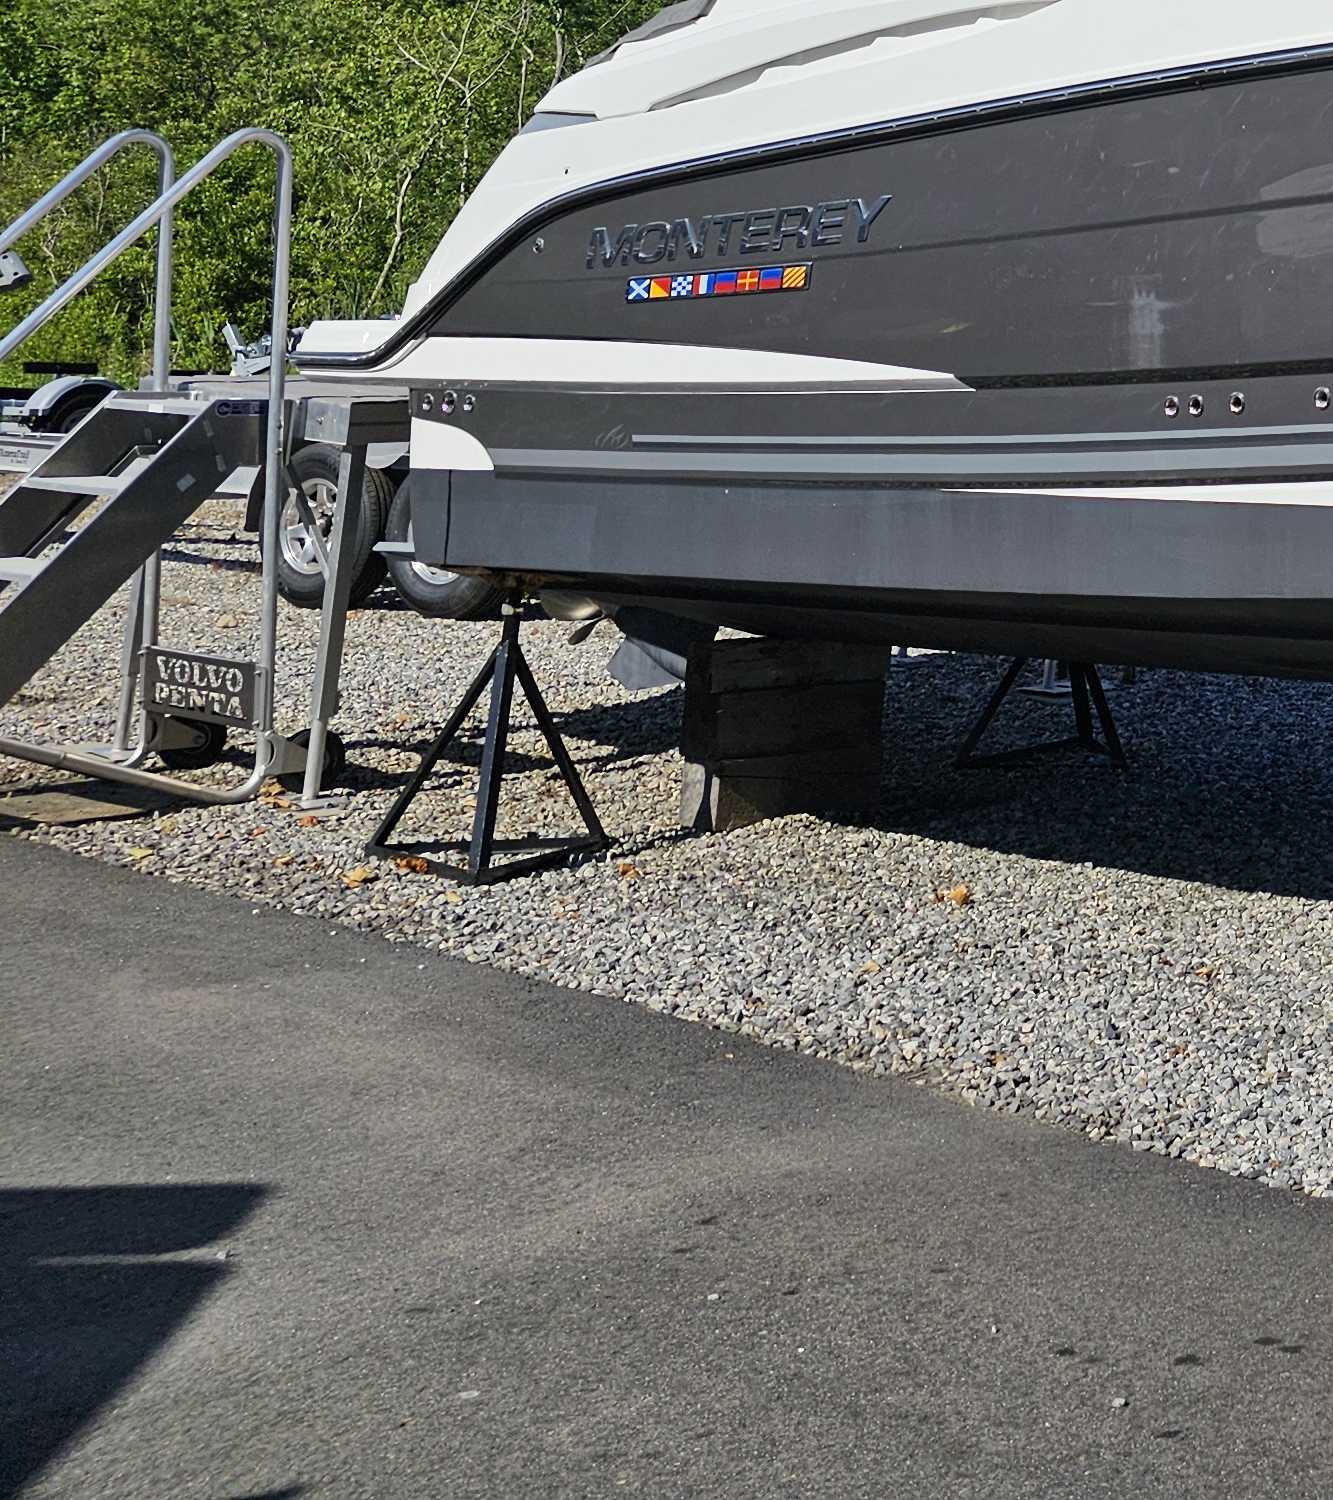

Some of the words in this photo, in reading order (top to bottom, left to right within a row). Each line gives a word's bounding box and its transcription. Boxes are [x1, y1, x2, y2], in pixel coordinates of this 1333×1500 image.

[585, 194, 893, 270] MONTEREY
[157, 655, 244, 693] VOLVO
[155, 682, 247, 719] PENTA
